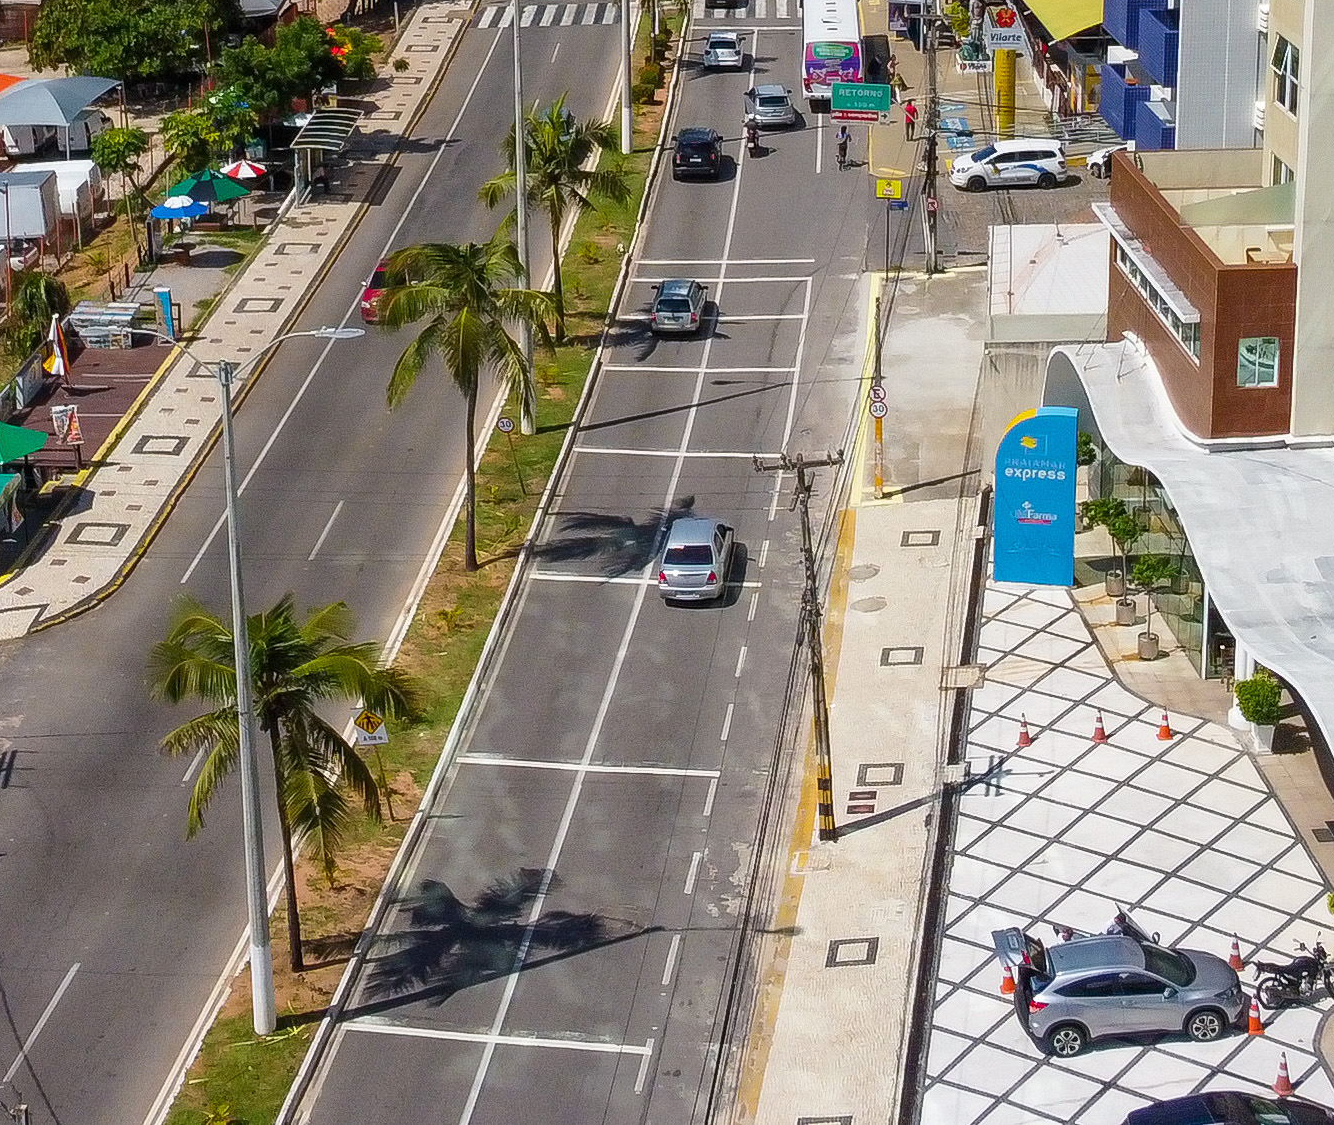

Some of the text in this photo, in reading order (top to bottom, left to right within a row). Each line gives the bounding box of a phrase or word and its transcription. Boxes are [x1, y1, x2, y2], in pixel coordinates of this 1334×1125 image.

[990, 33, 1022, 43] Vilarte
[838, 88, 883, 98] RETORNO
[499, 420, 512, 428] 30
[1005, 467, 1066, 481] express
